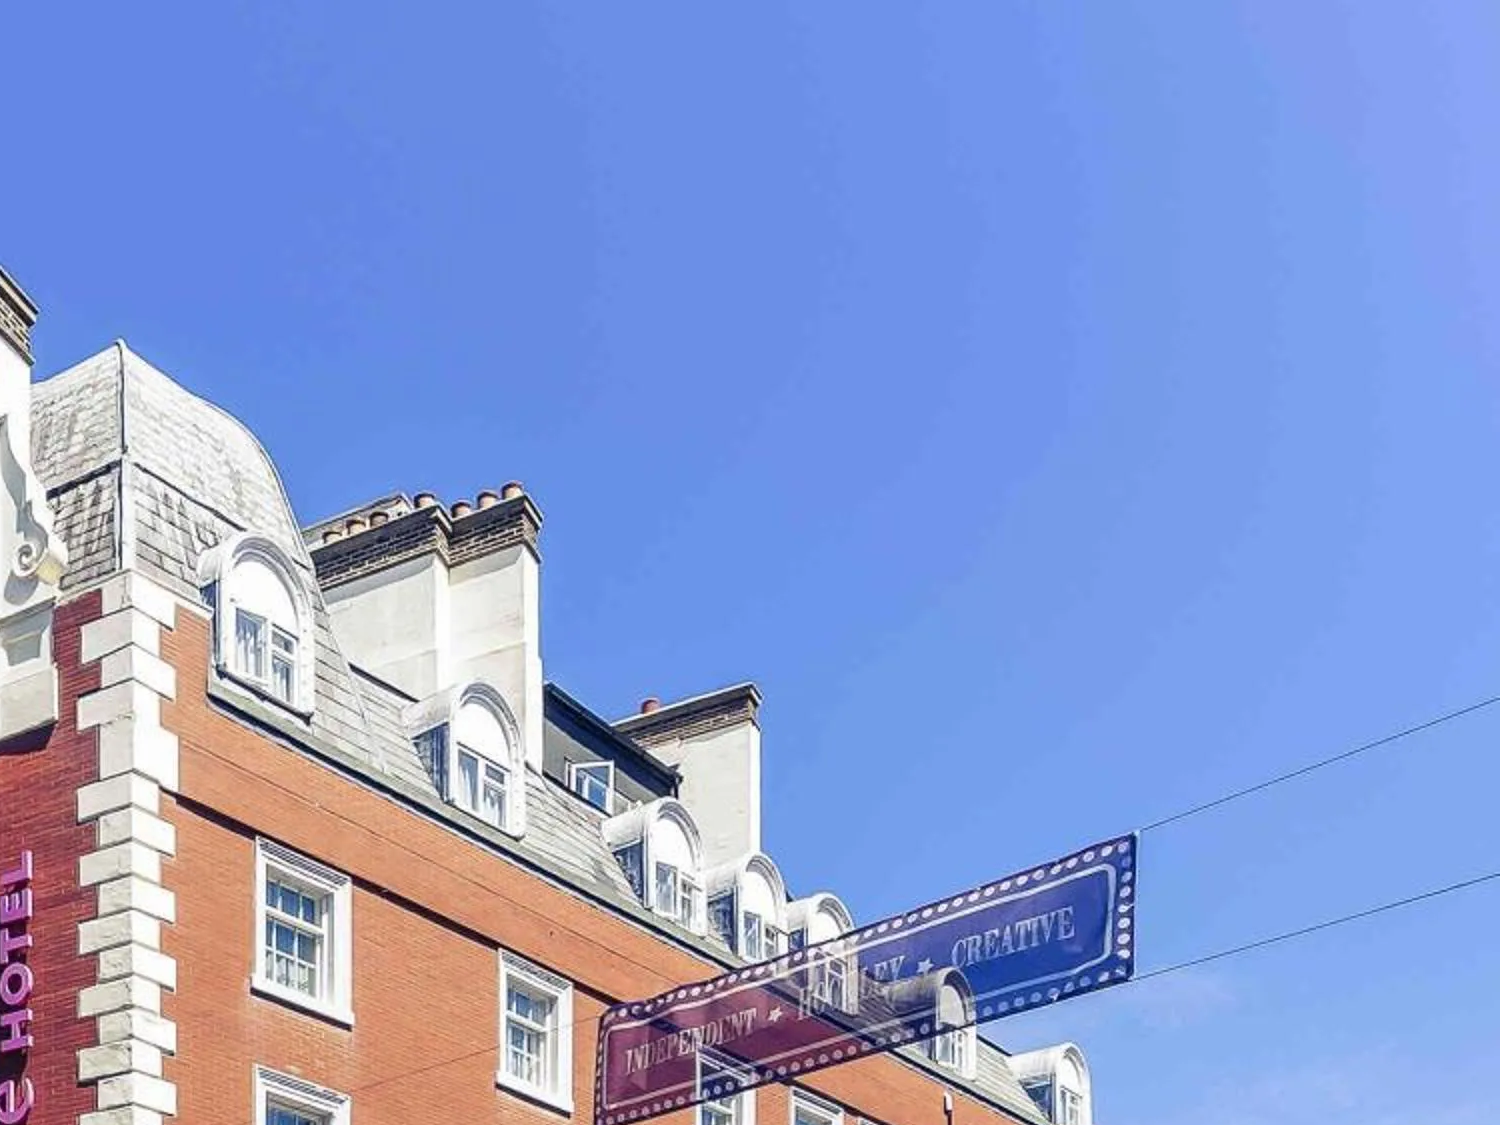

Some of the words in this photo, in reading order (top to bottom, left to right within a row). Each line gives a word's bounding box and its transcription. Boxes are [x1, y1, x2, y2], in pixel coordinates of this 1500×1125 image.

[0, 850, 33, 1053] HOTEL
[625, 1007, 757, 1076] INDEPENDENT
[951, 905, 1075, 968] CREATIVE
